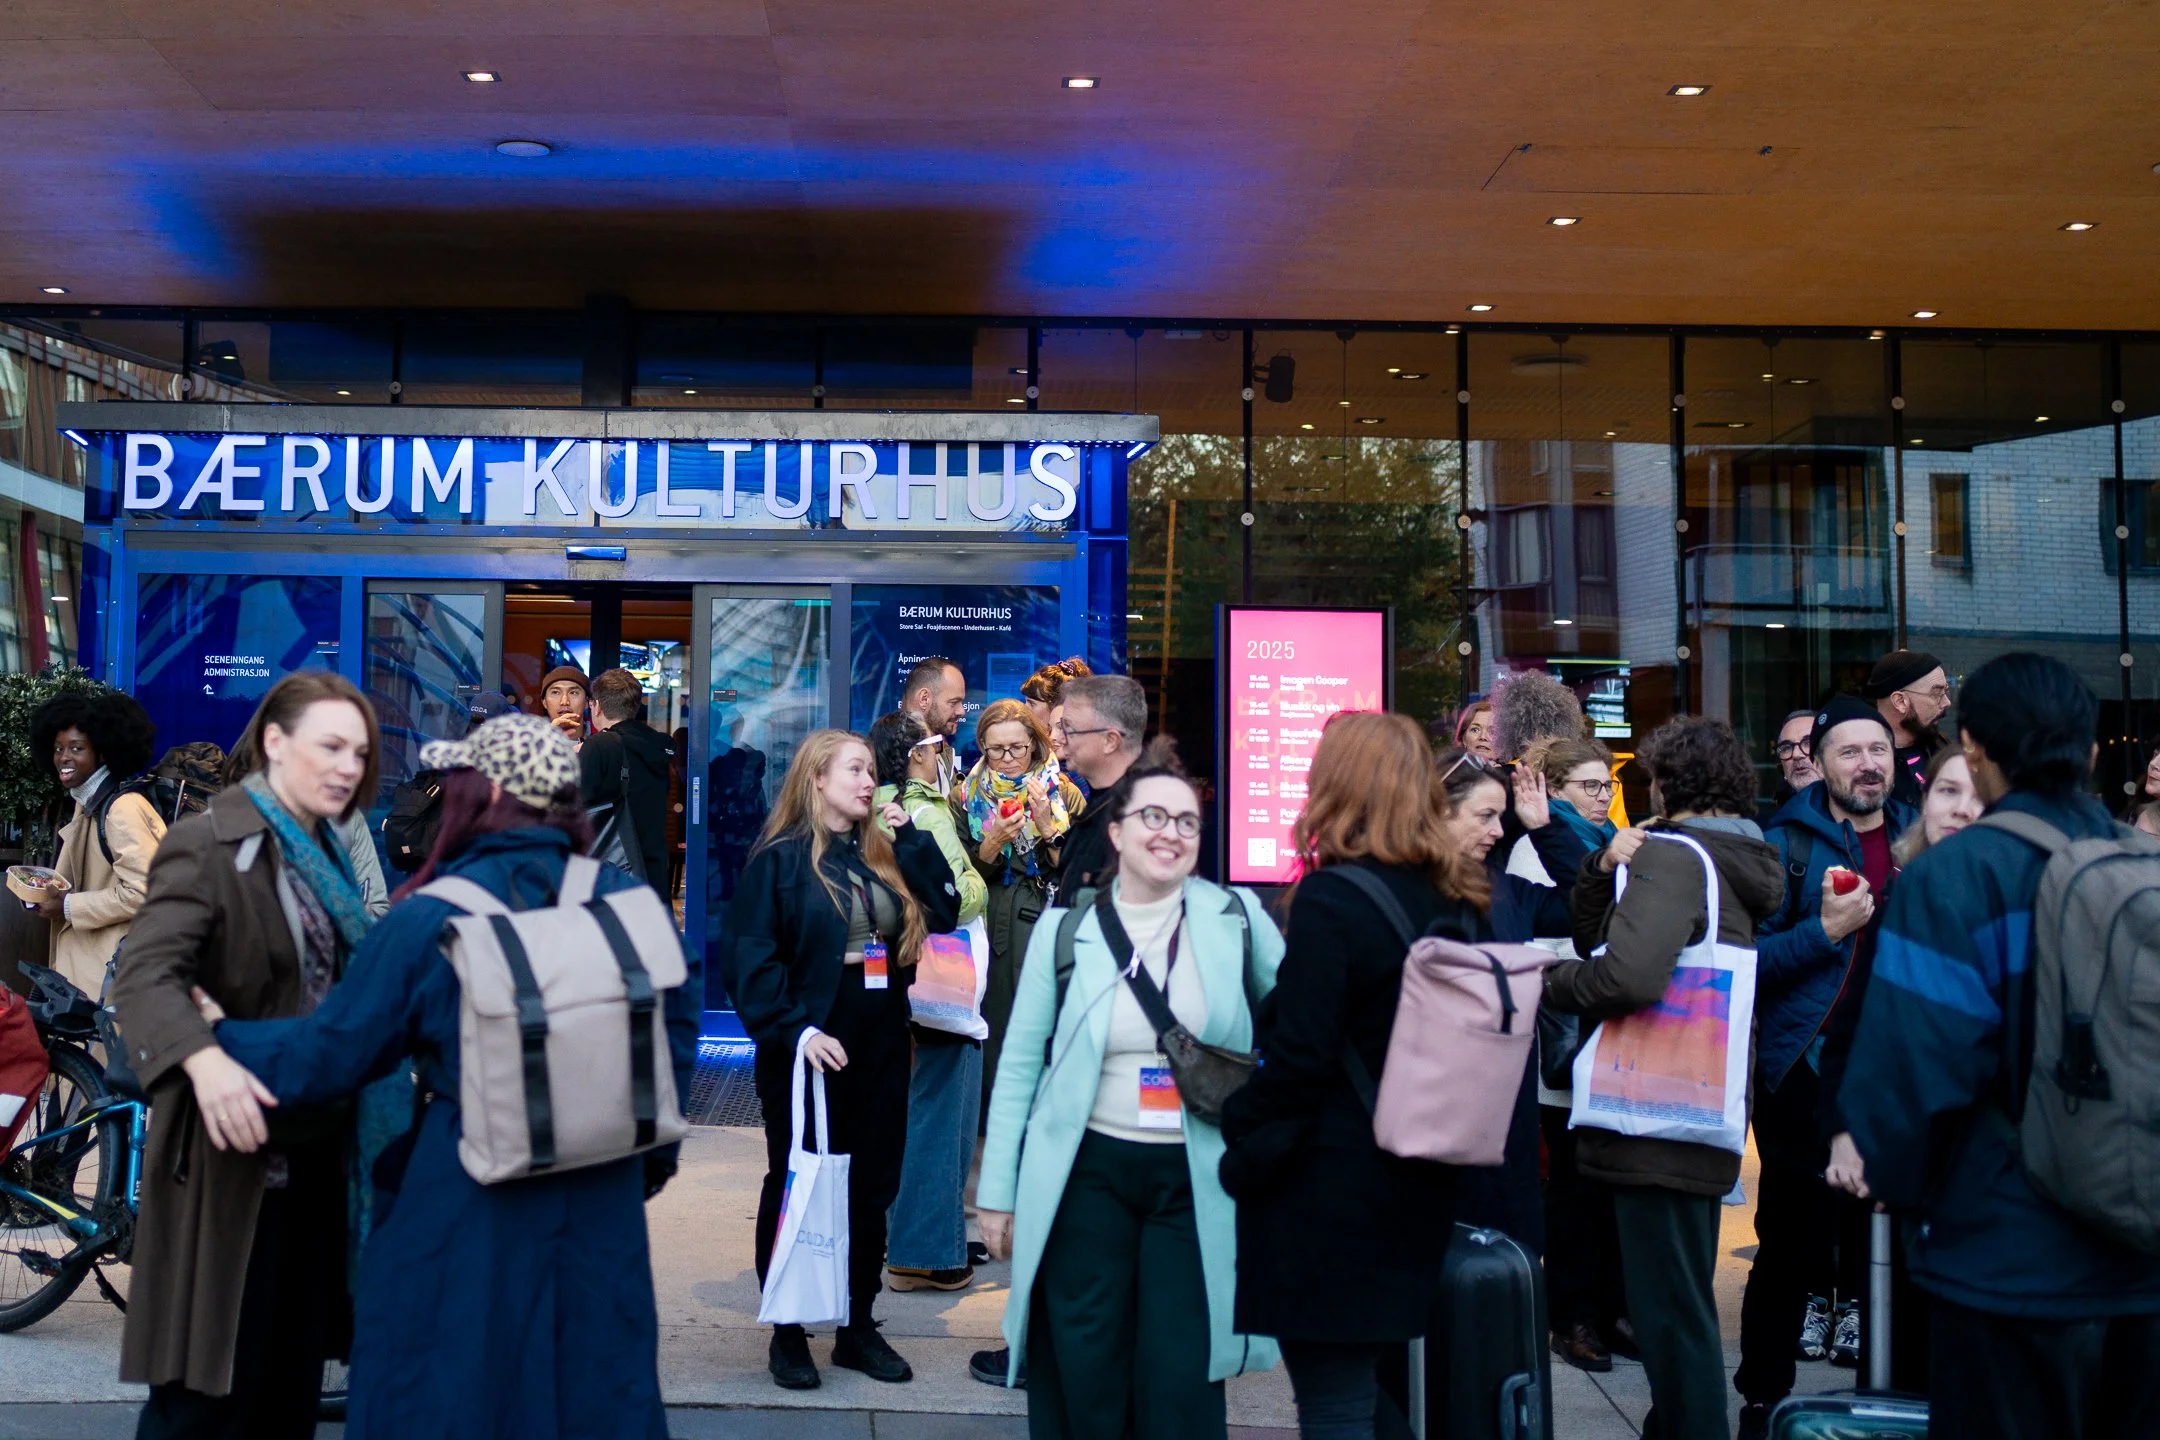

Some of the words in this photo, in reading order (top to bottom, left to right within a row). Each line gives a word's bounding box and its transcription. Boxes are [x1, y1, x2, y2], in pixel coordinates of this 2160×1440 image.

[123, 434, 474, 514] BÆRUM
[523, 438, 1077, 522] KULTURHUS
[900, 606, 943, 618] BÆRUM
[946, 607, 1012, 619] KULTURHUS
[926, 623, 961, 632] Foajéscenen
[1247, 640, 1295, 660] 2025
[204, 655, 265, 665] SCENEINNGANG
[203, 667, 270, 677] ADMINISTRASJON
[471, 706, 488, 714] CODA
